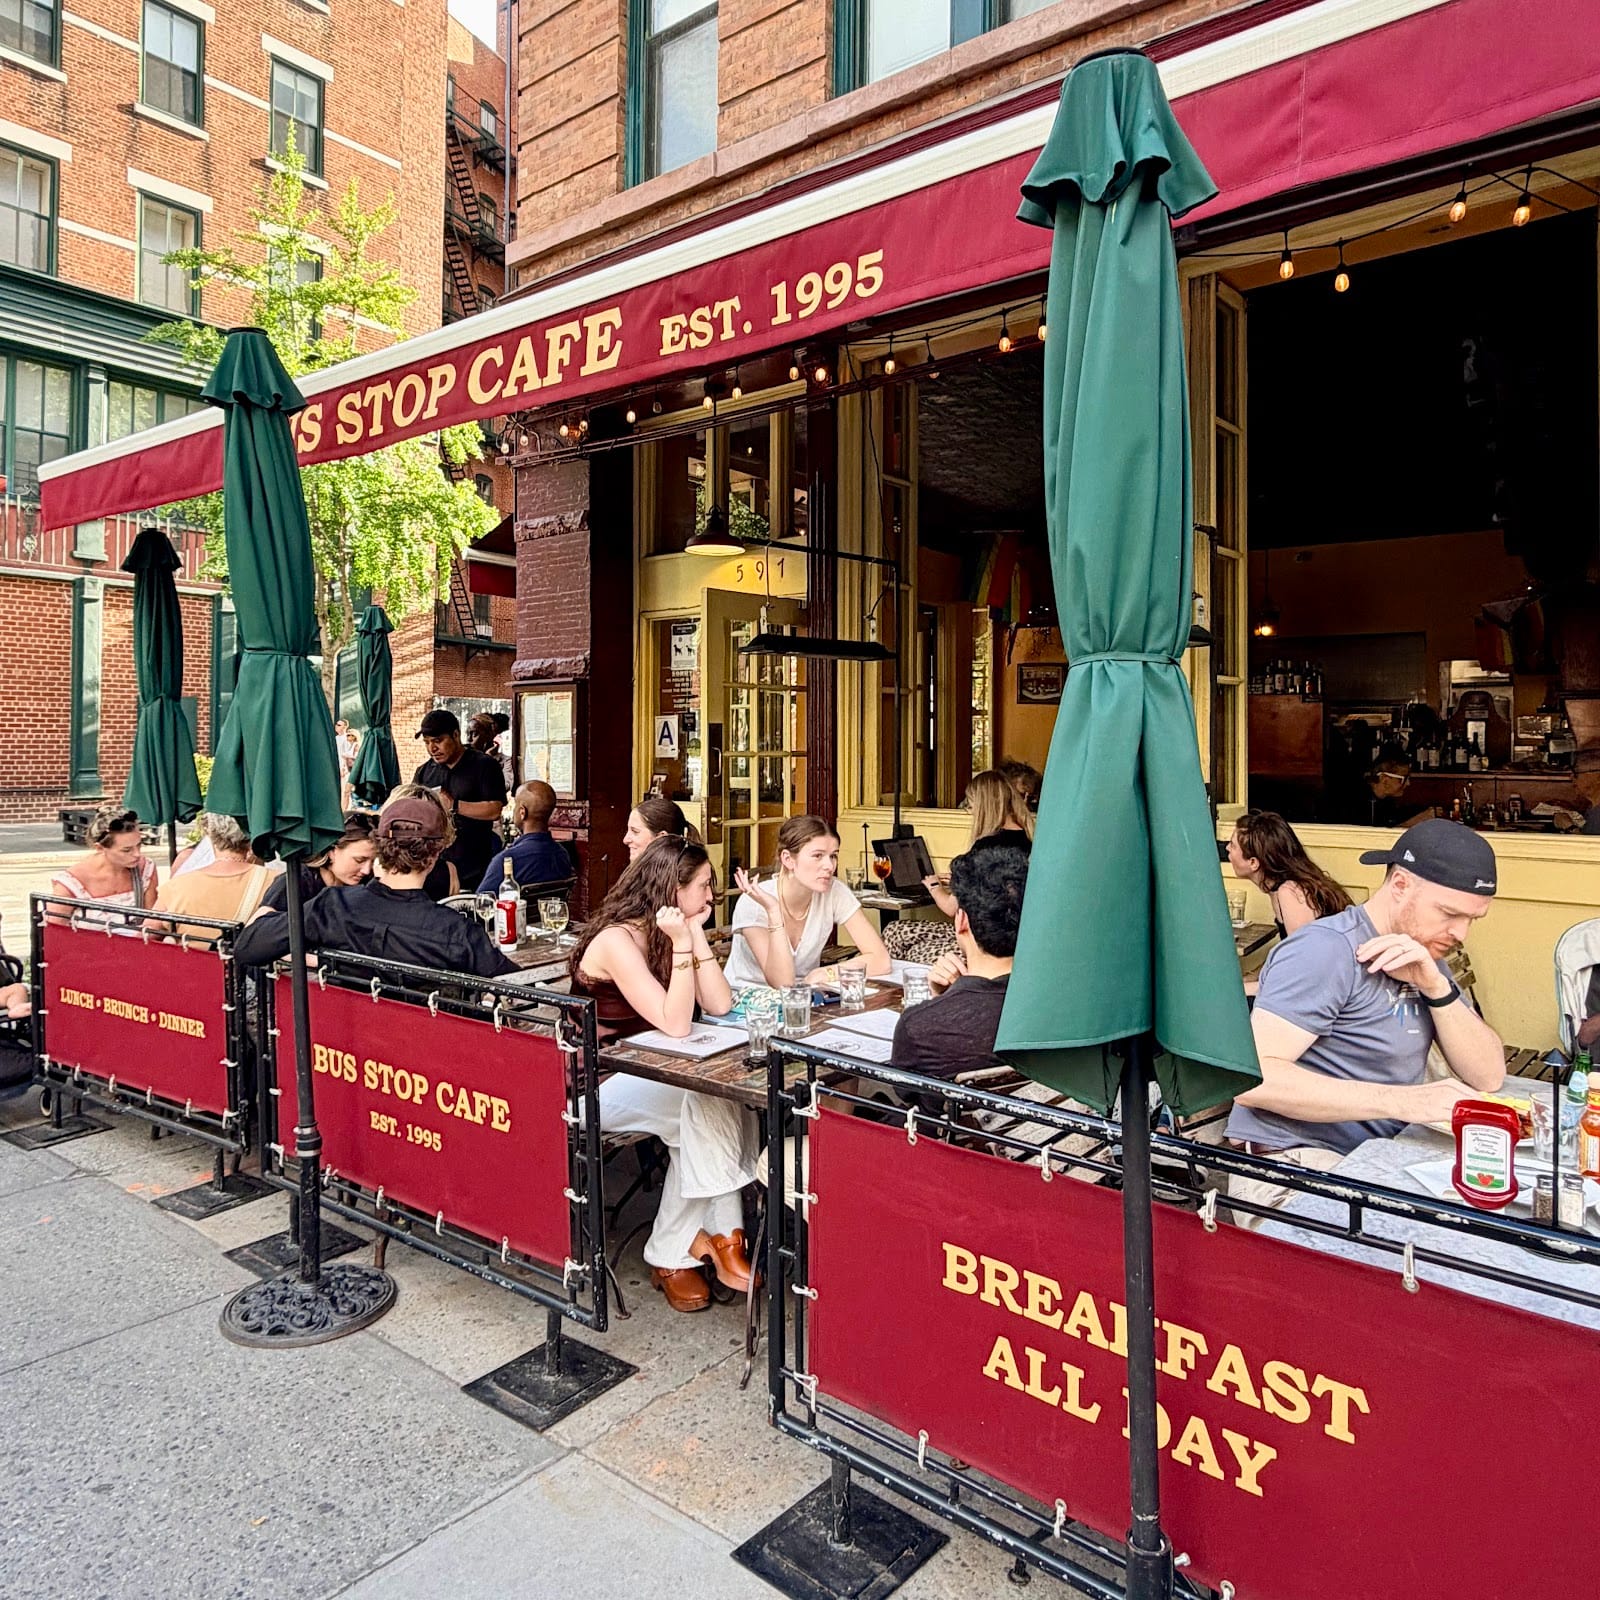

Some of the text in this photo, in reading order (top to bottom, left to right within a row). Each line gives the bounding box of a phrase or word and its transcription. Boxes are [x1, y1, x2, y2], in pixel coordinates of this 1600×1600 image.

[335, 363, 457, 445] STOP
[467, 306, 623, 405] CAFE
[659, 295, 753, 356] EST.
[770, 248, 884, 326] 1995
[736, 557, 785, 583] 591
[658, 720, 674, 745] A
[60, 987, 206, 1039] LUNCH BRUNCH DINNER
[313, 1043, 511, 1133] BUS STOP CAFE
[370, 1110, 442, 1152] EST. 1995
[982, 1335, 1102, 1424] ALL
